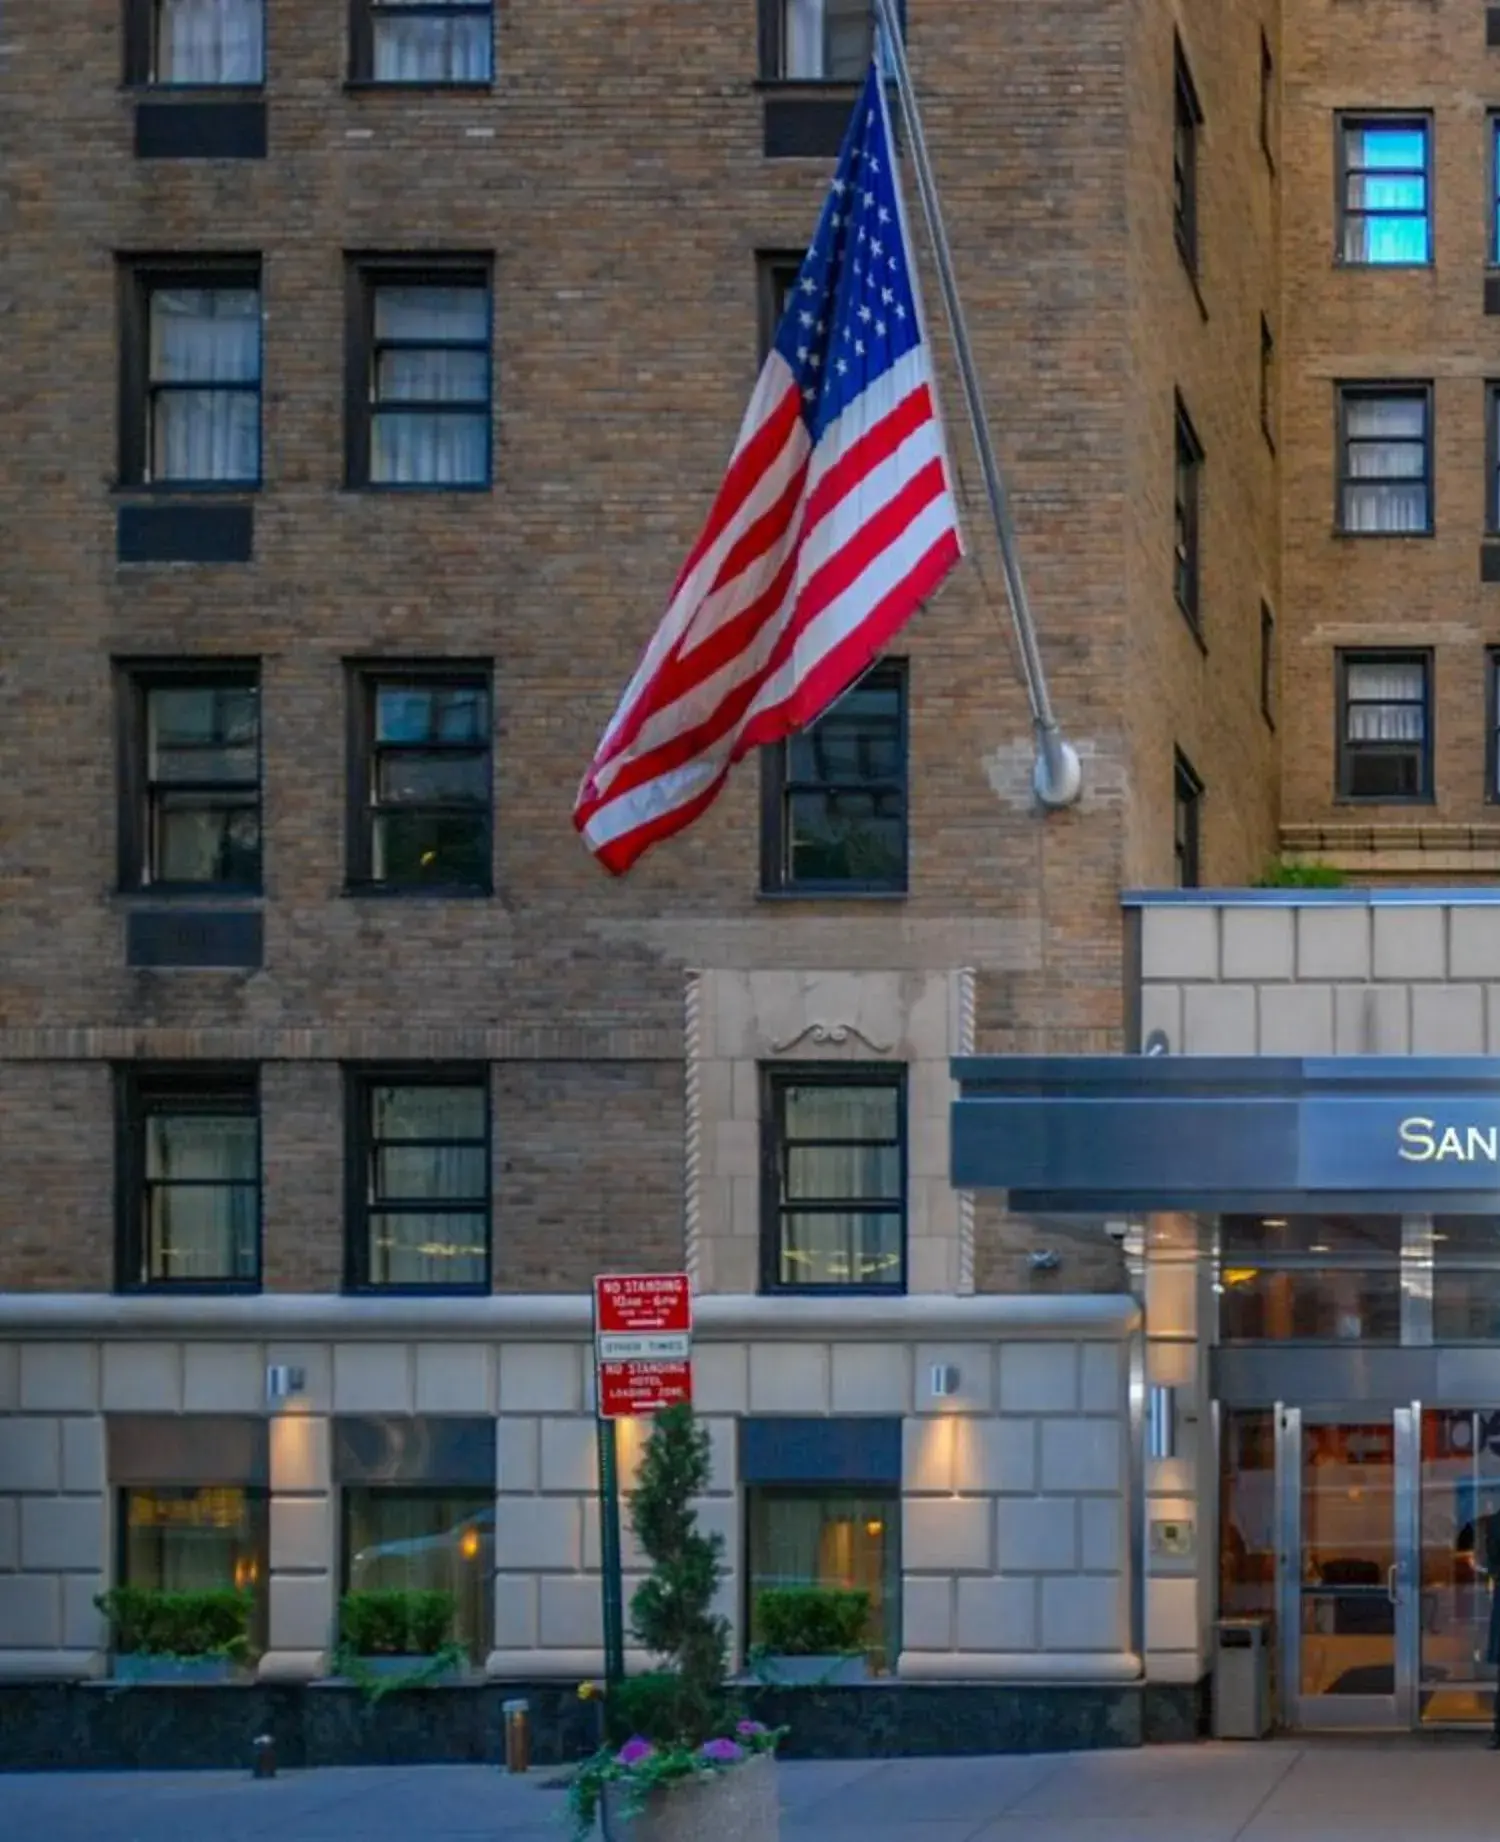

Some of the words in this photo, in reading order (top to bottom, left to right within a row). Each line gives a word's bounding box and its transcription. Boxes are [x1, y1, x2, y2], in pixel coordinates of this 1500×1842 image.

[1397, 1117, 1498, 1162] SAN
[603, 1281, 621, 1293] NO
[624, 1279, 682, 1292] STANDING
[605, 1363, 622, 1375] NO
[626, 1362, 685, 1375] STANDING
[629, 1375, 663, 1386] HOTEL
